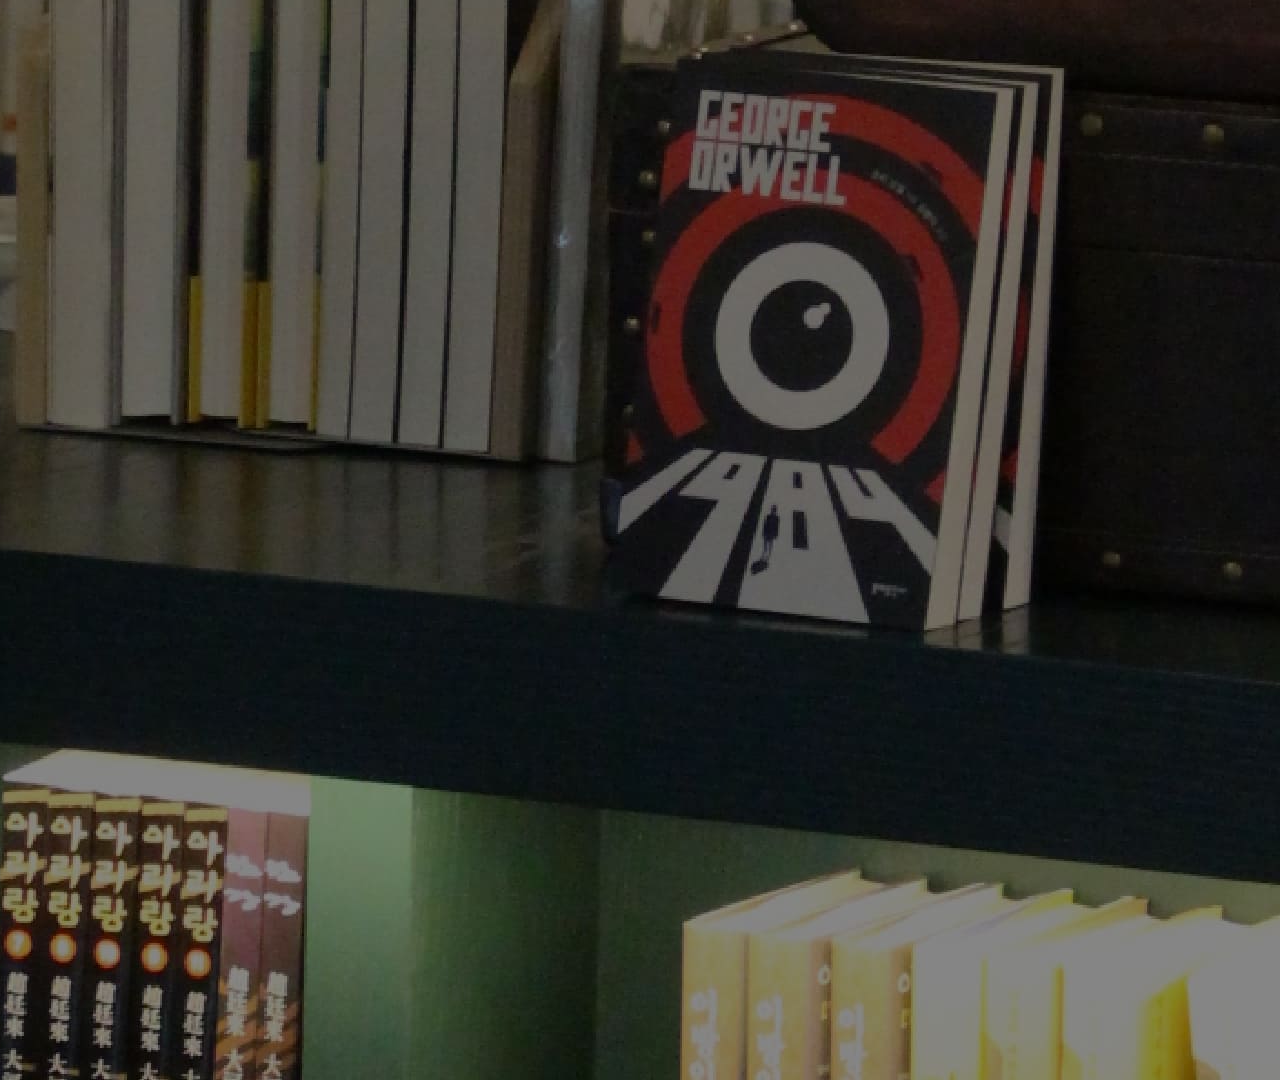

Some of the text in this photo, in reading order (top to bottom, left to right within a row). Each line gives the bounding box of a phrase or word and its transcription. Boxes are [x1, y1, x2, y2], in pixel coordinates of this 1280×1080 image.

[696, 89, 837, 152] GEORGE
[688, 138, 848, 206] ORWELL
[618, 448, 939, 624] 1984
